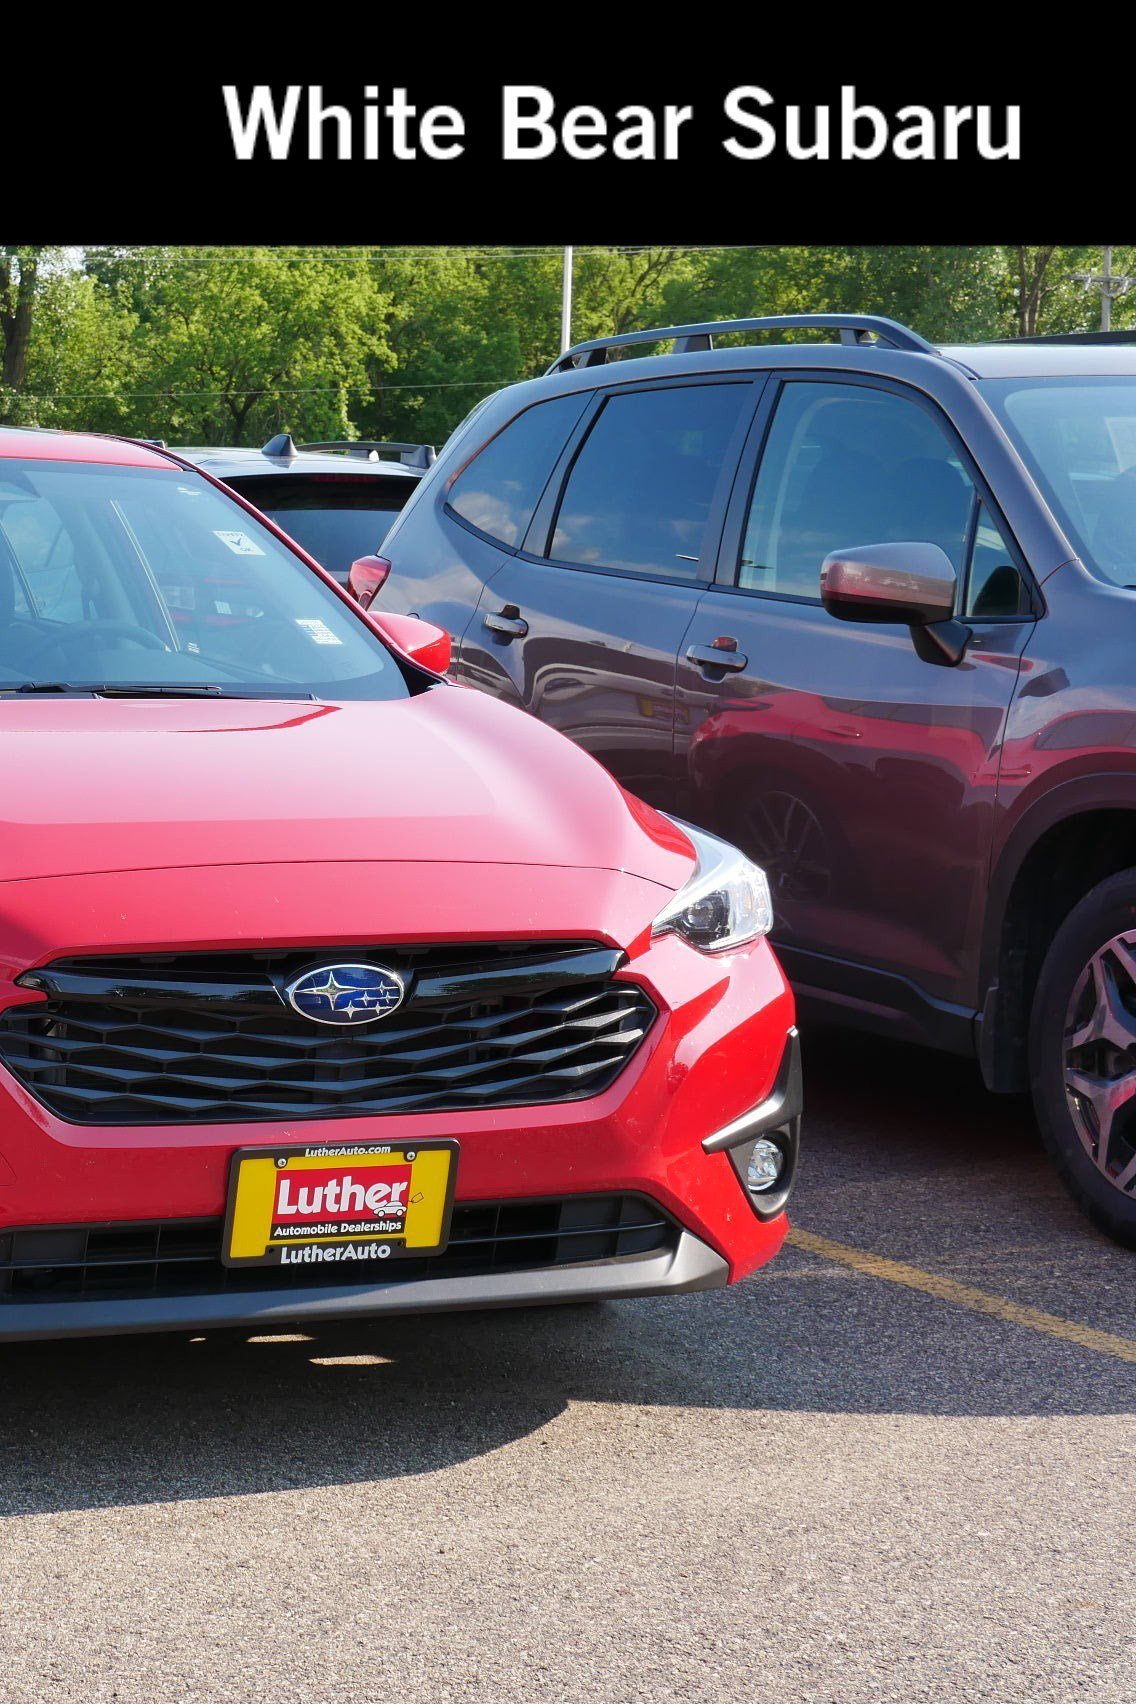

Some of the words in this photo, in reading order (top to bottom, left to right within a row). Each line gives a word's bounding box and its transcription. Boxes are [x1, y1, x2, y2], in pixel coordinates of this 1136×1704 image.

[304, 1145, 391, 1158] LutherAuto.com
[276, 1175, 409, 1215] Luther
[274, 1223, 338, 1237] Automobile
[340, 1220, 402, 1233] Dealerships
[280, 1242, 391, 1264] LutherAuto
